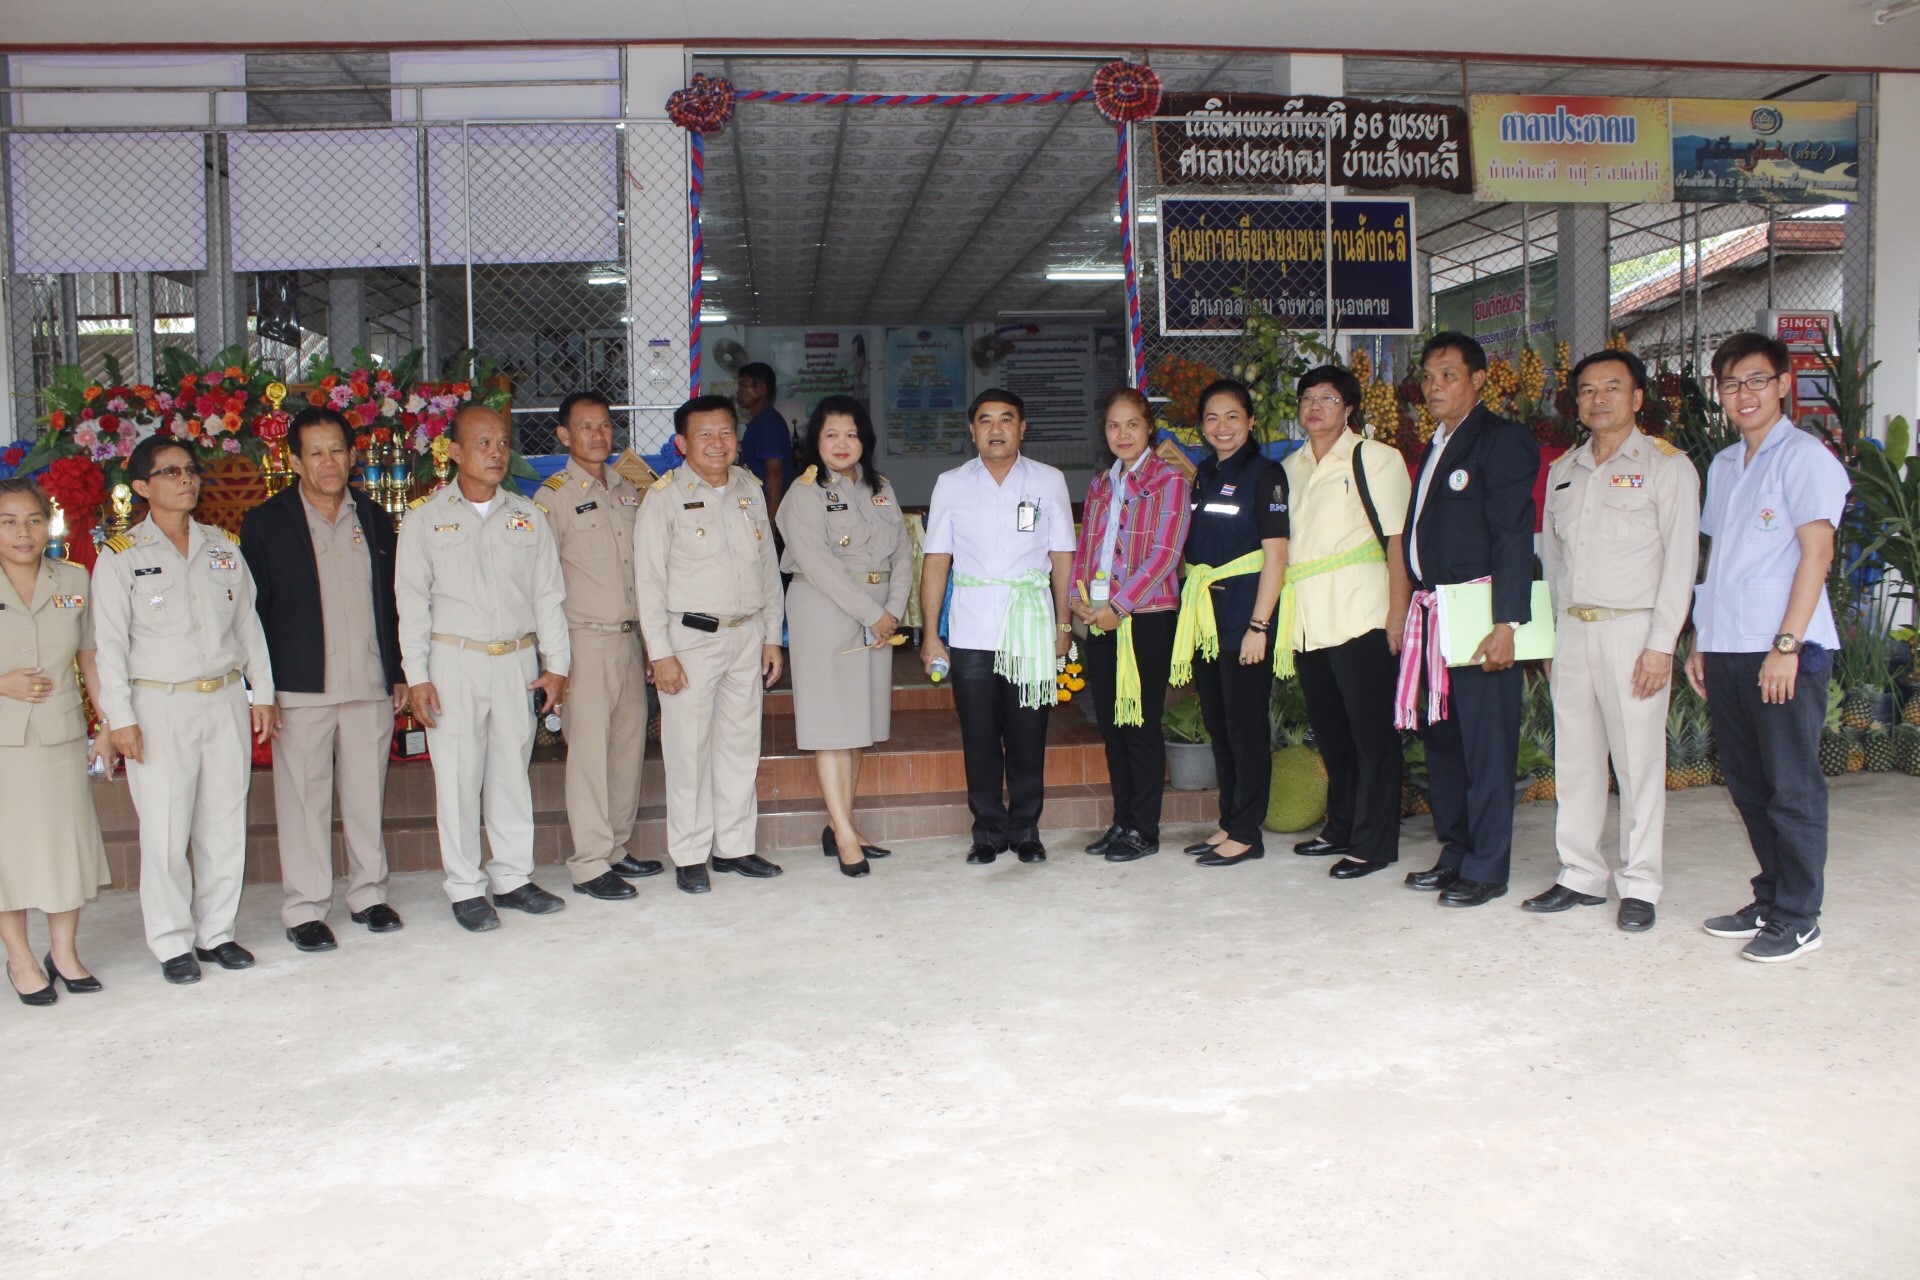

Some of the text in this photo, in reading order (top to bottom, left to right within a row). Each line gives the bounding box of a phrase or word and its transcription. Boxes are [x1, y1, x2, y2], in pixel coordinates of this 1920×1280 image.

[1353, 112, 1384, 140] 86
[1388, 112, 1449, 141] พรรษา
[1501, 106, 1636, 144] ศาลาประชาคม
[1179, 139, 1460, 180] ศาลาประชาคม บ้านสังกะลี
[1593, 165, 1601, 180] 5
[1474, 287, 1525, 321] ยินดีต้อนรั
[1780, 318, 1828, 328] SINGER
